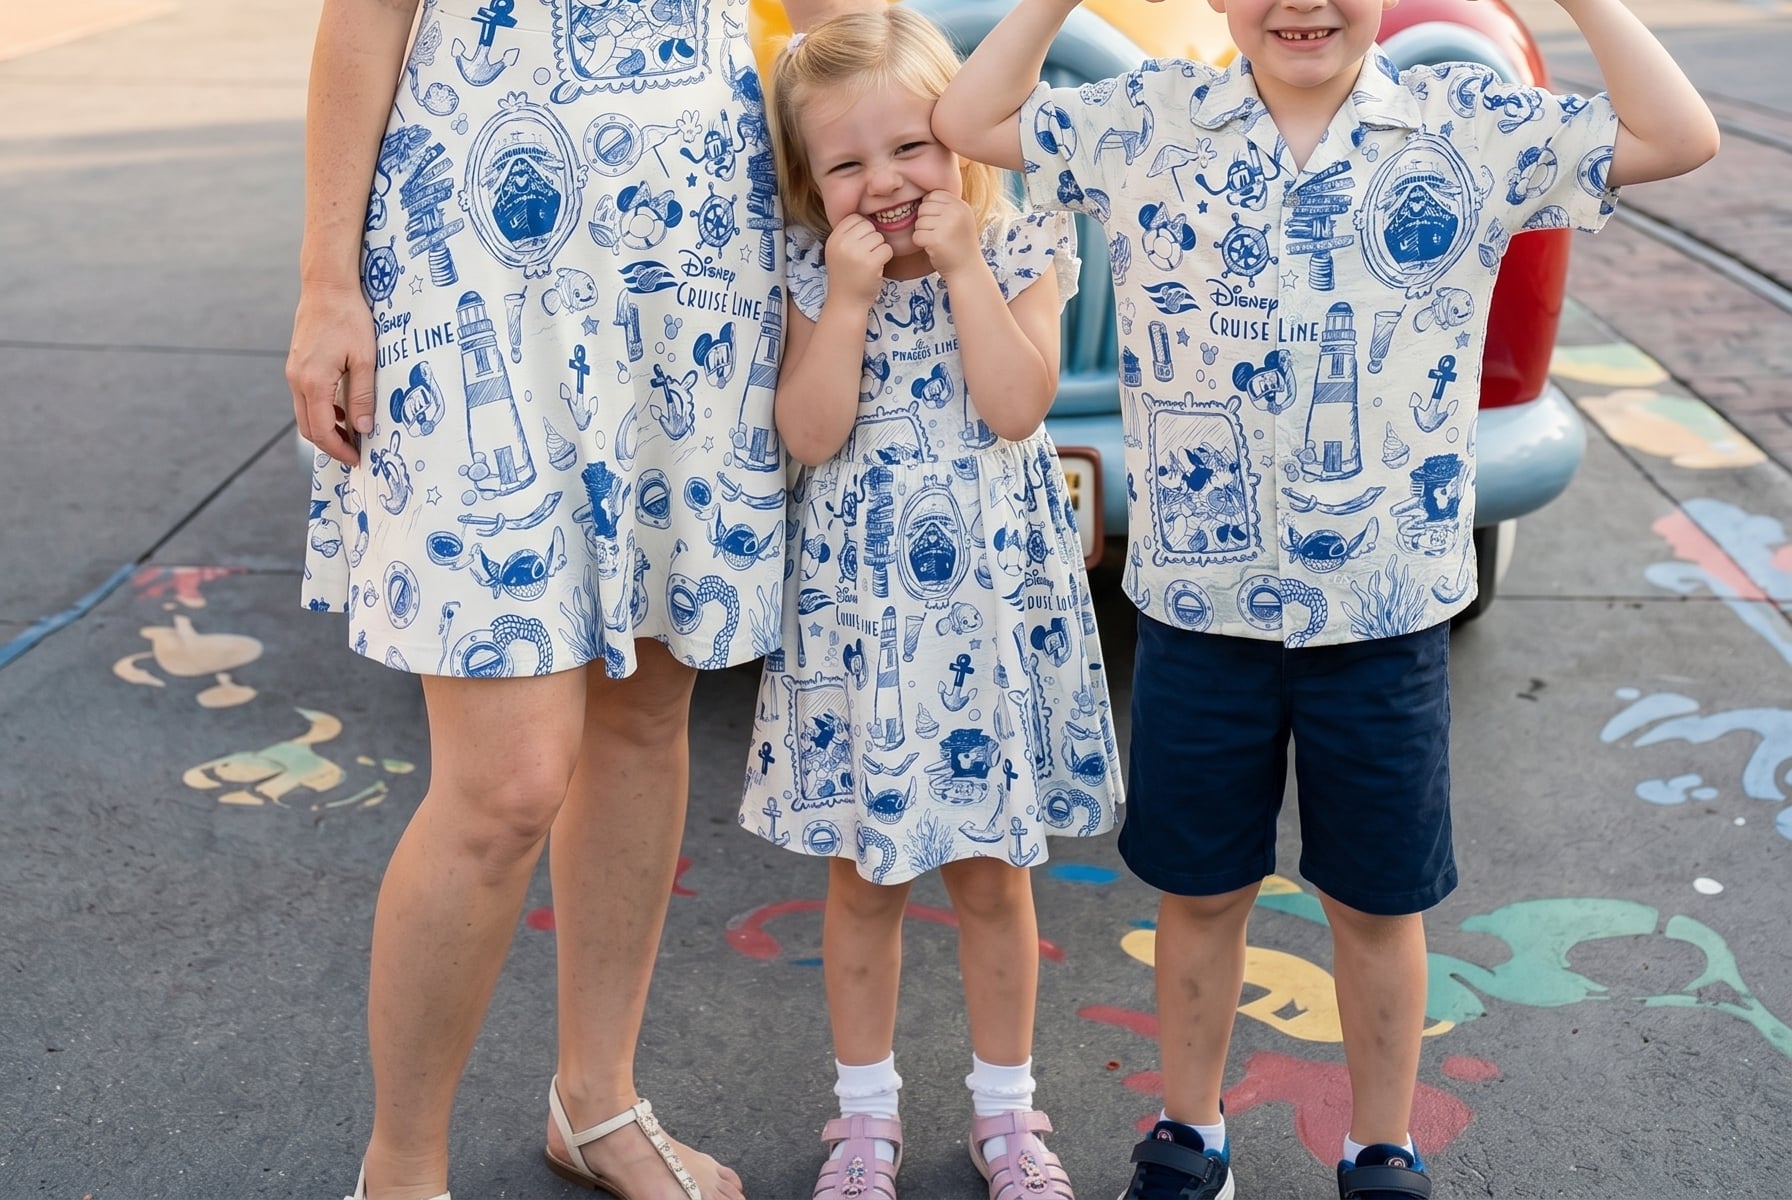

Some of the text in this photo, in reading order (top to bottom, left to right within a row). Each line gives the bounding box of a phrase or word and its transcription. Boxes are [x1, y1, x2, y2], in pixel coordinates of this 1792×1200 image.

[678, 249, 736, 291] Disney
[676, 281, 762, 321] CRUISE LINE
[1205, 278, 1279, 320] Disney
[377, 321, 455, 369] UISE LINE
[1209, 310, 1319, 343] CRUISE LINE
